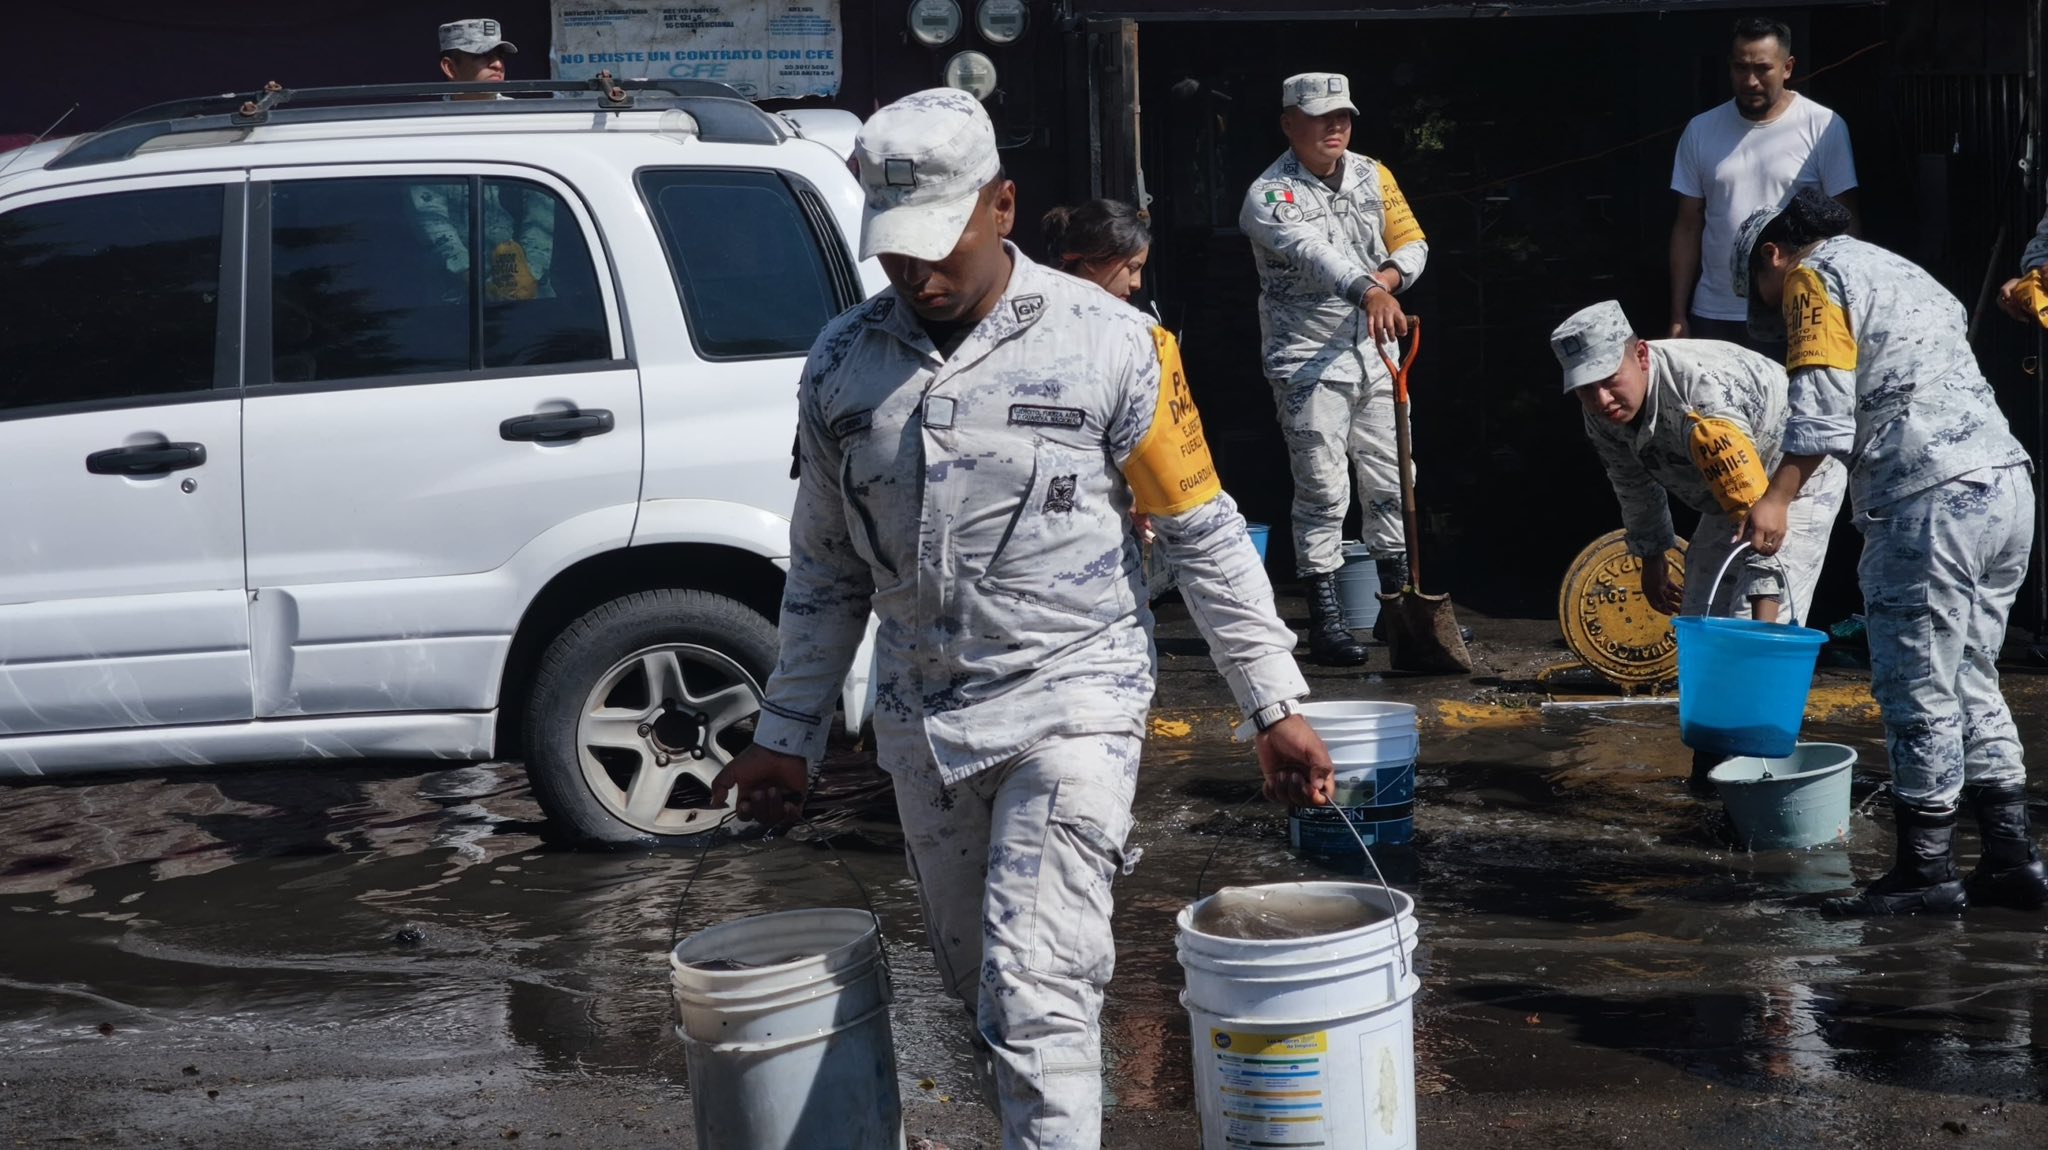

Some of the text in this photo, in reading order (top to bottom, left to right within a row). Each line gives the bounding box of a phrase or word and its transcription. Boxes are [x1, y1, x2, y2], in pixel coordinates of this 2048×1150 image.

[560, 49, 835, 64] NO EXISTE UN CONTRATO CON CFE
[669, 62, 728, 78] CFE
[1018, 303, 1041, 315] GN
[1792, 292, 1810, 311] AN
[1699, 434, 1732, 460] PLAN
[1703, 450, 1749, 481] DN-III-E
